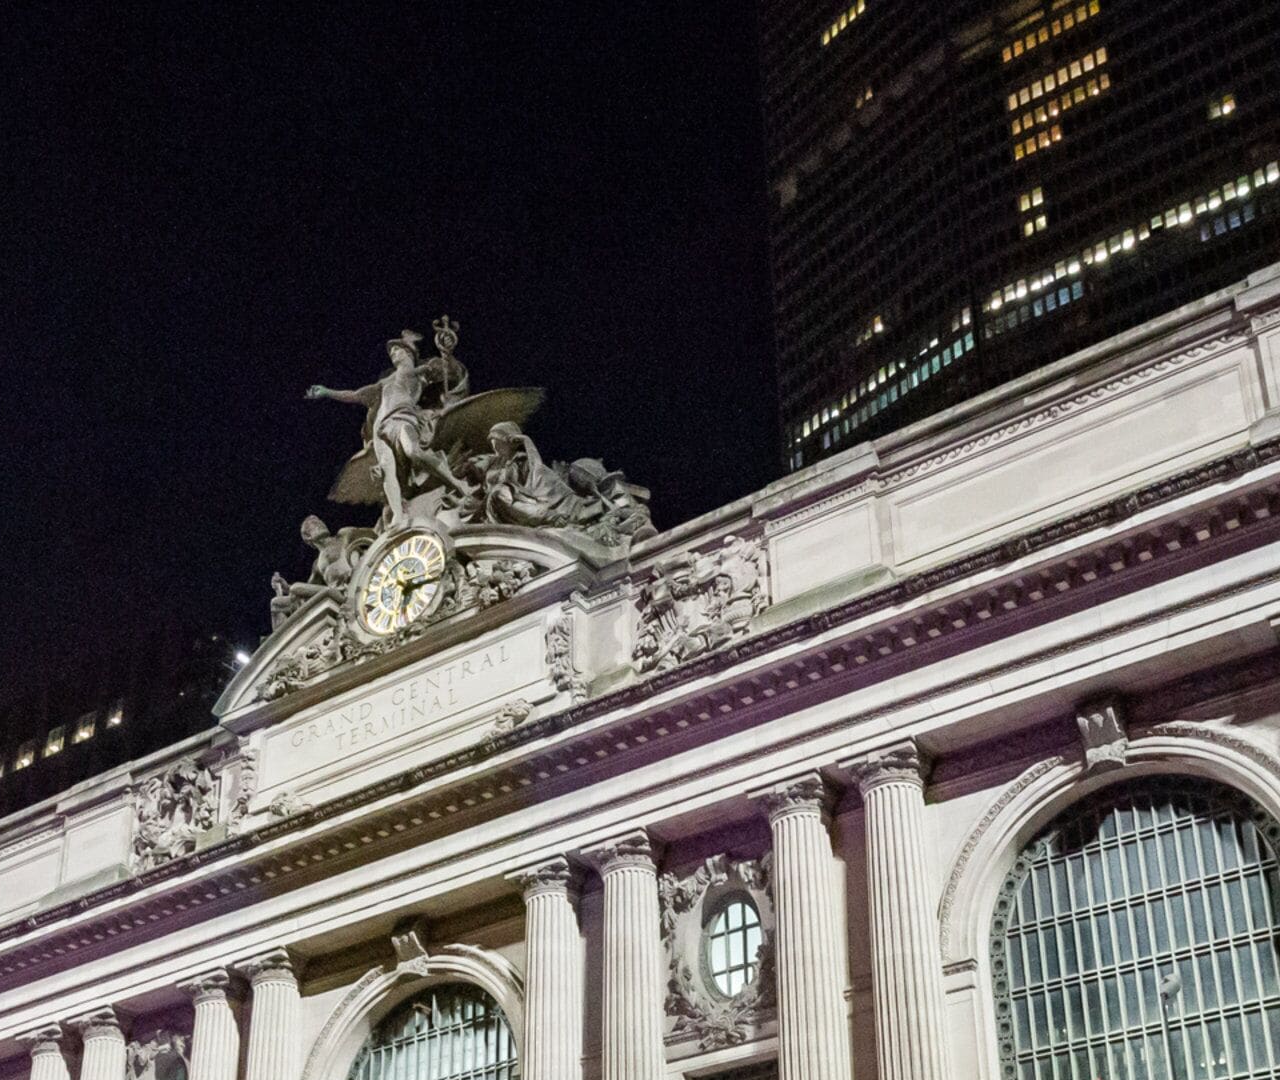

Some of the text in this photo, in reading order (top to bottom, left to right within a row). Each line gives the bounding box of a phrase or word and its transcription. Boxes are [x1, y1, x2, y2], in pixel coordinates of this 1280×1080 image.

[291, 645, 510, 749] GRAND CENTRAL
[335, 688, 457, 751] TERMINAL
